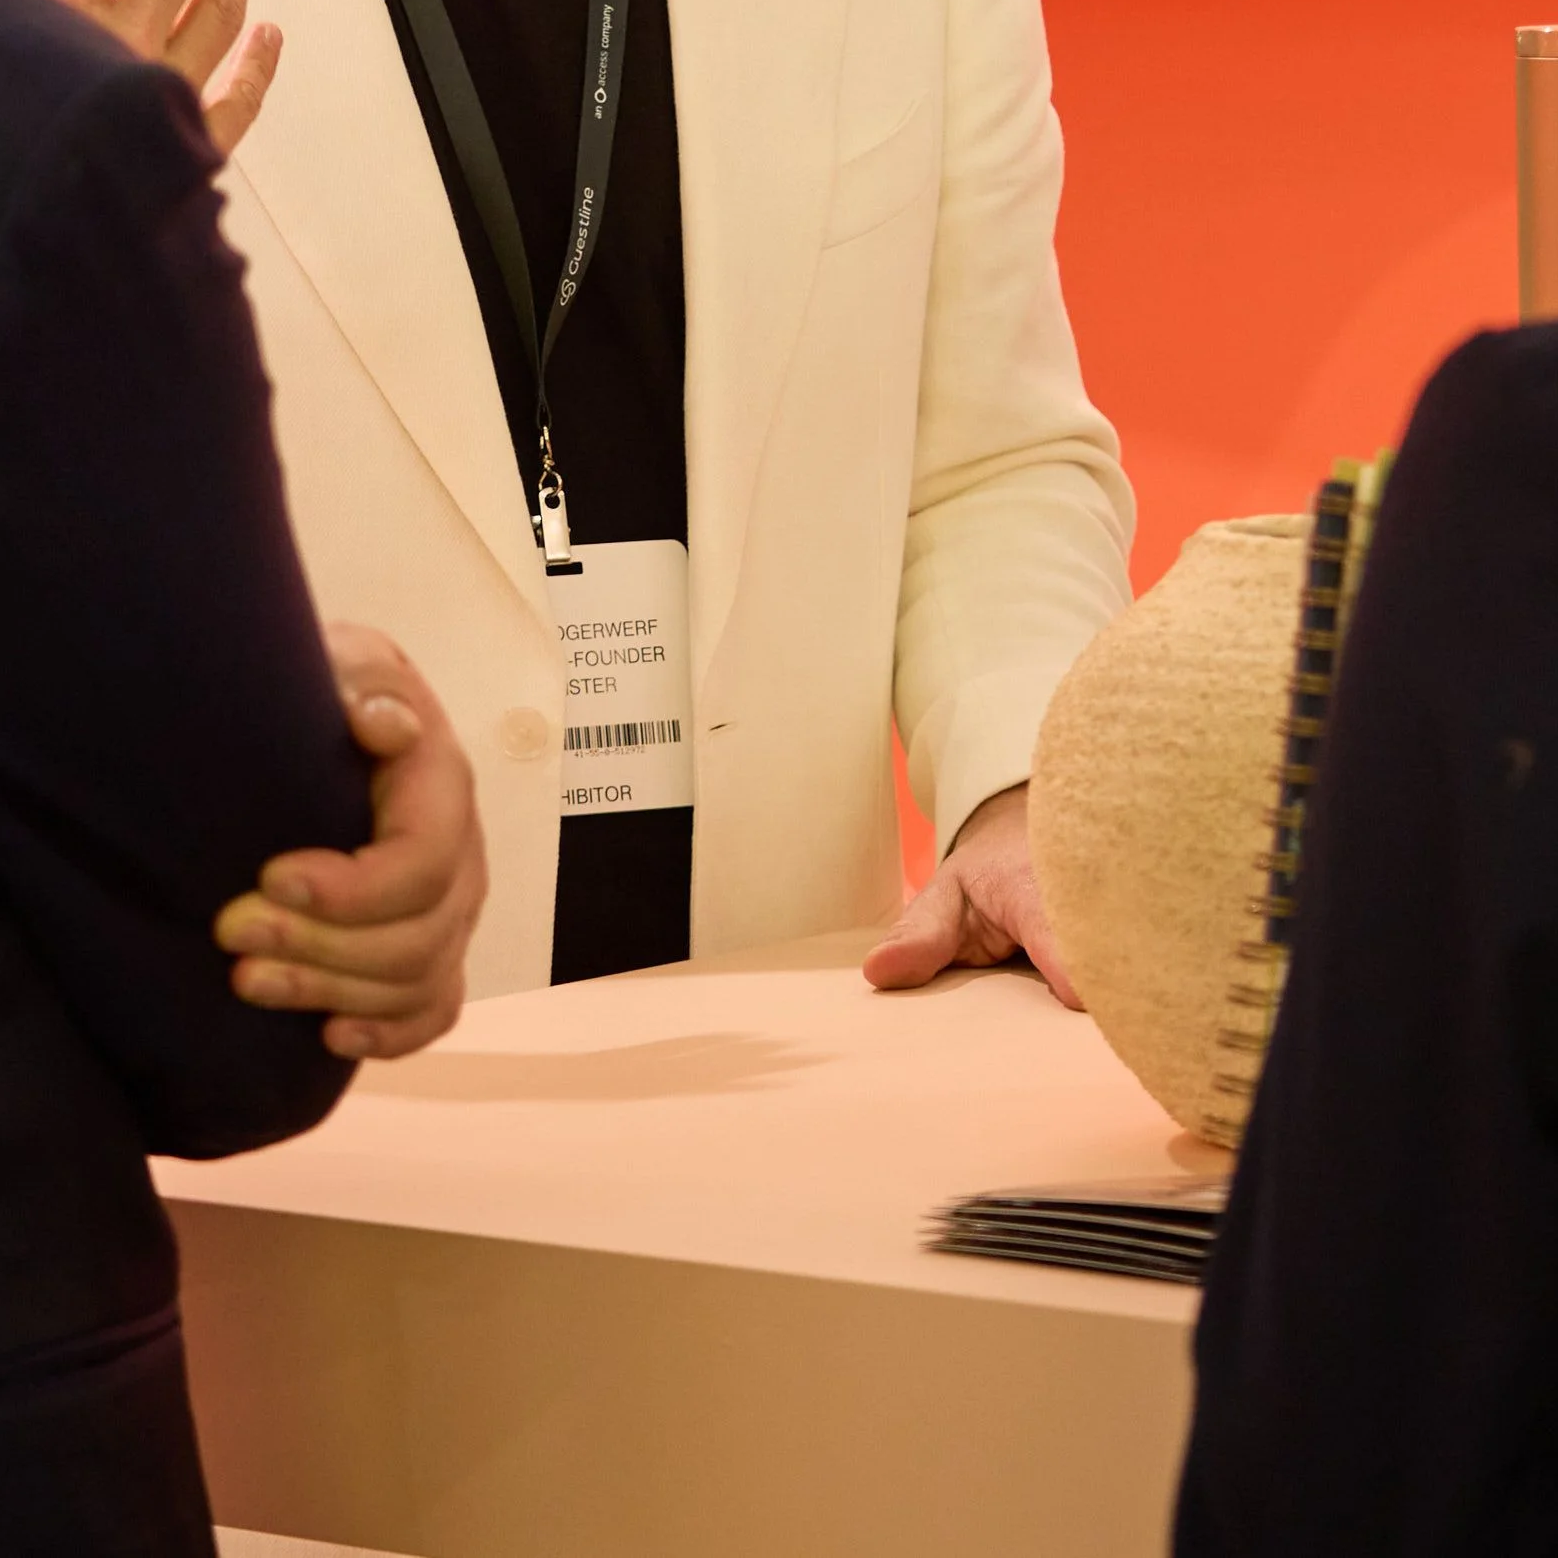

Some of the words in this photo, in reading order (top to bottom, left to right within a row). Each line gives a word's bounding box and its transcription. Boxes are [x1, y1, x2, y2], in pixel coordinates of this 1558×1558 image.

[601, 3, 615, 49] company
[597, 49, 609, 87] access
[594, 104, 603, 120] an
[568, 186, 595, 276] Guestline
[565, 676, 618, 696] STER
